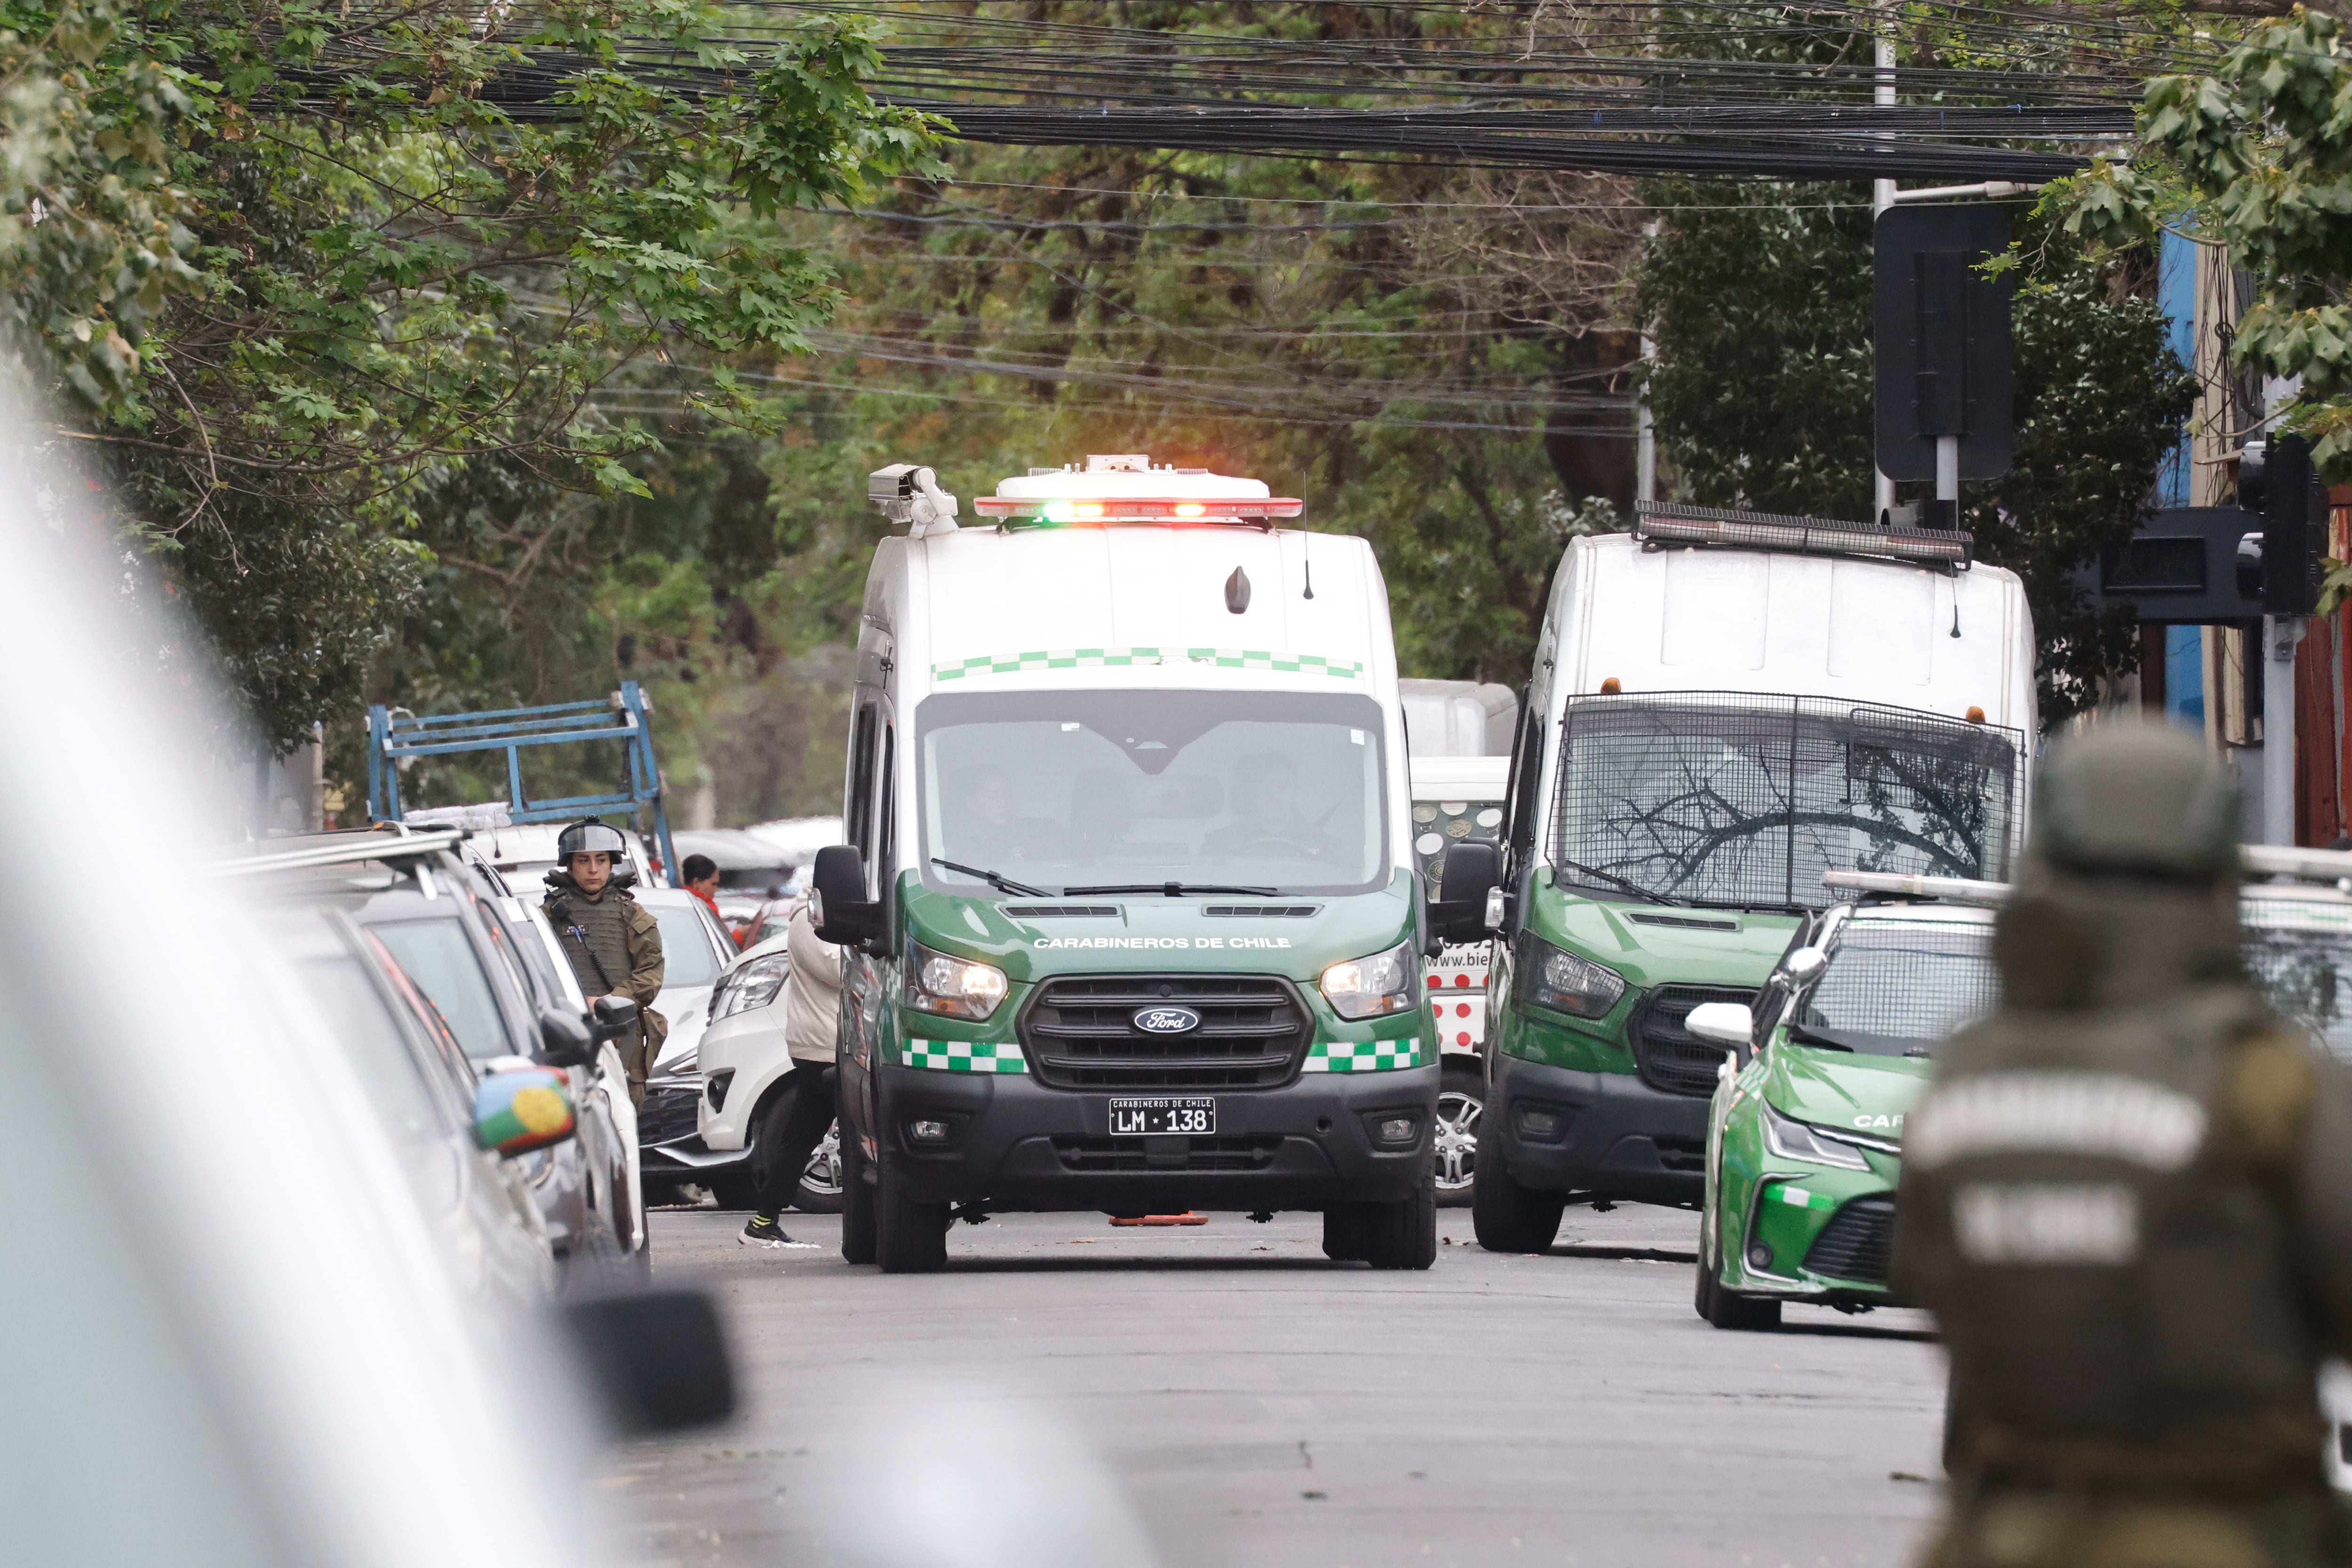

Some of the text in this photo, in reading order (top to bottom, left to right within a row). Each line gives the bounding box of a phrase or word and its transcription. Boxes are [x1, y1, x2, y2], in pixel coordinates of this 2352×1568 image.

[1033, 938, 1292, 948] CARABINEROS DE CHILE
[1146, 1012, 1185, 1028] Ford
[1118, 1110, 1207, 1131] LM 138
